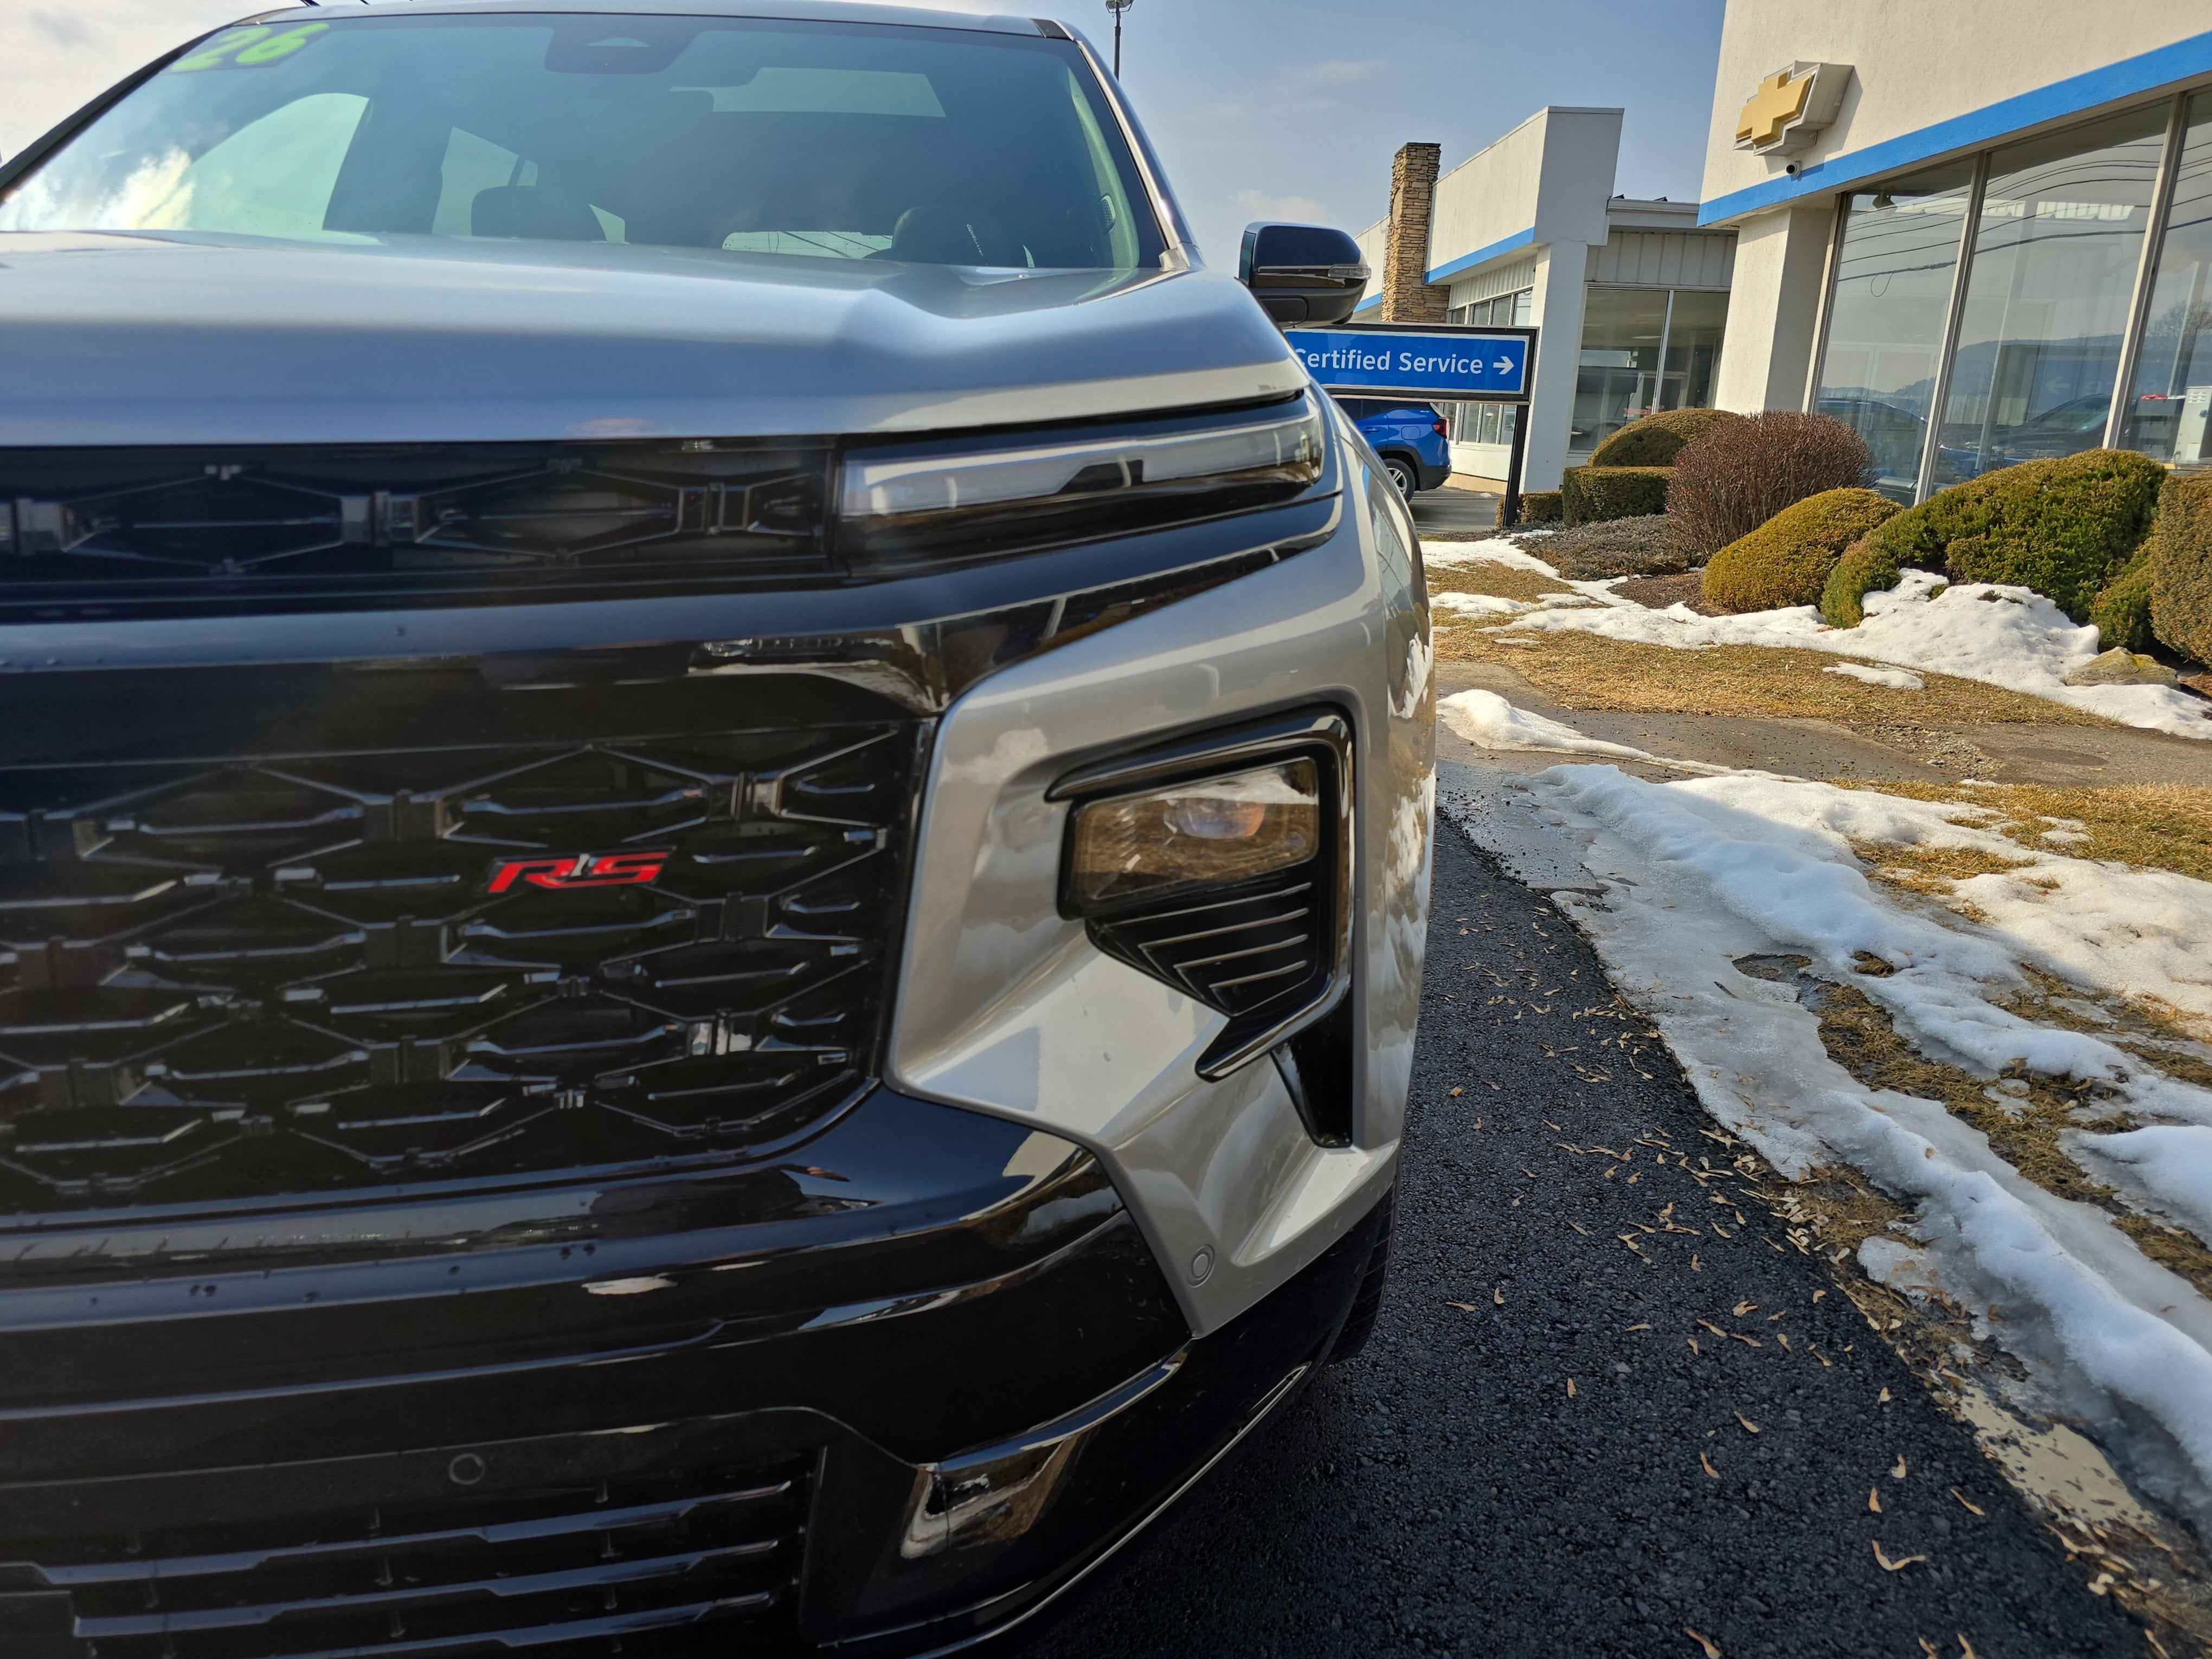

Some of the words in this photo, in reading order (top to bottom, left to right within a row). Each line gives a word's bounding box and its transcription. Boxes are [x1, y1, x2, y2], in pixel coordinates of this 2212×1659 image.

[171, 23, 330, 72] 26
[1398, 352, 1483, 374] Service
[487, 852, 668, 893] RS
